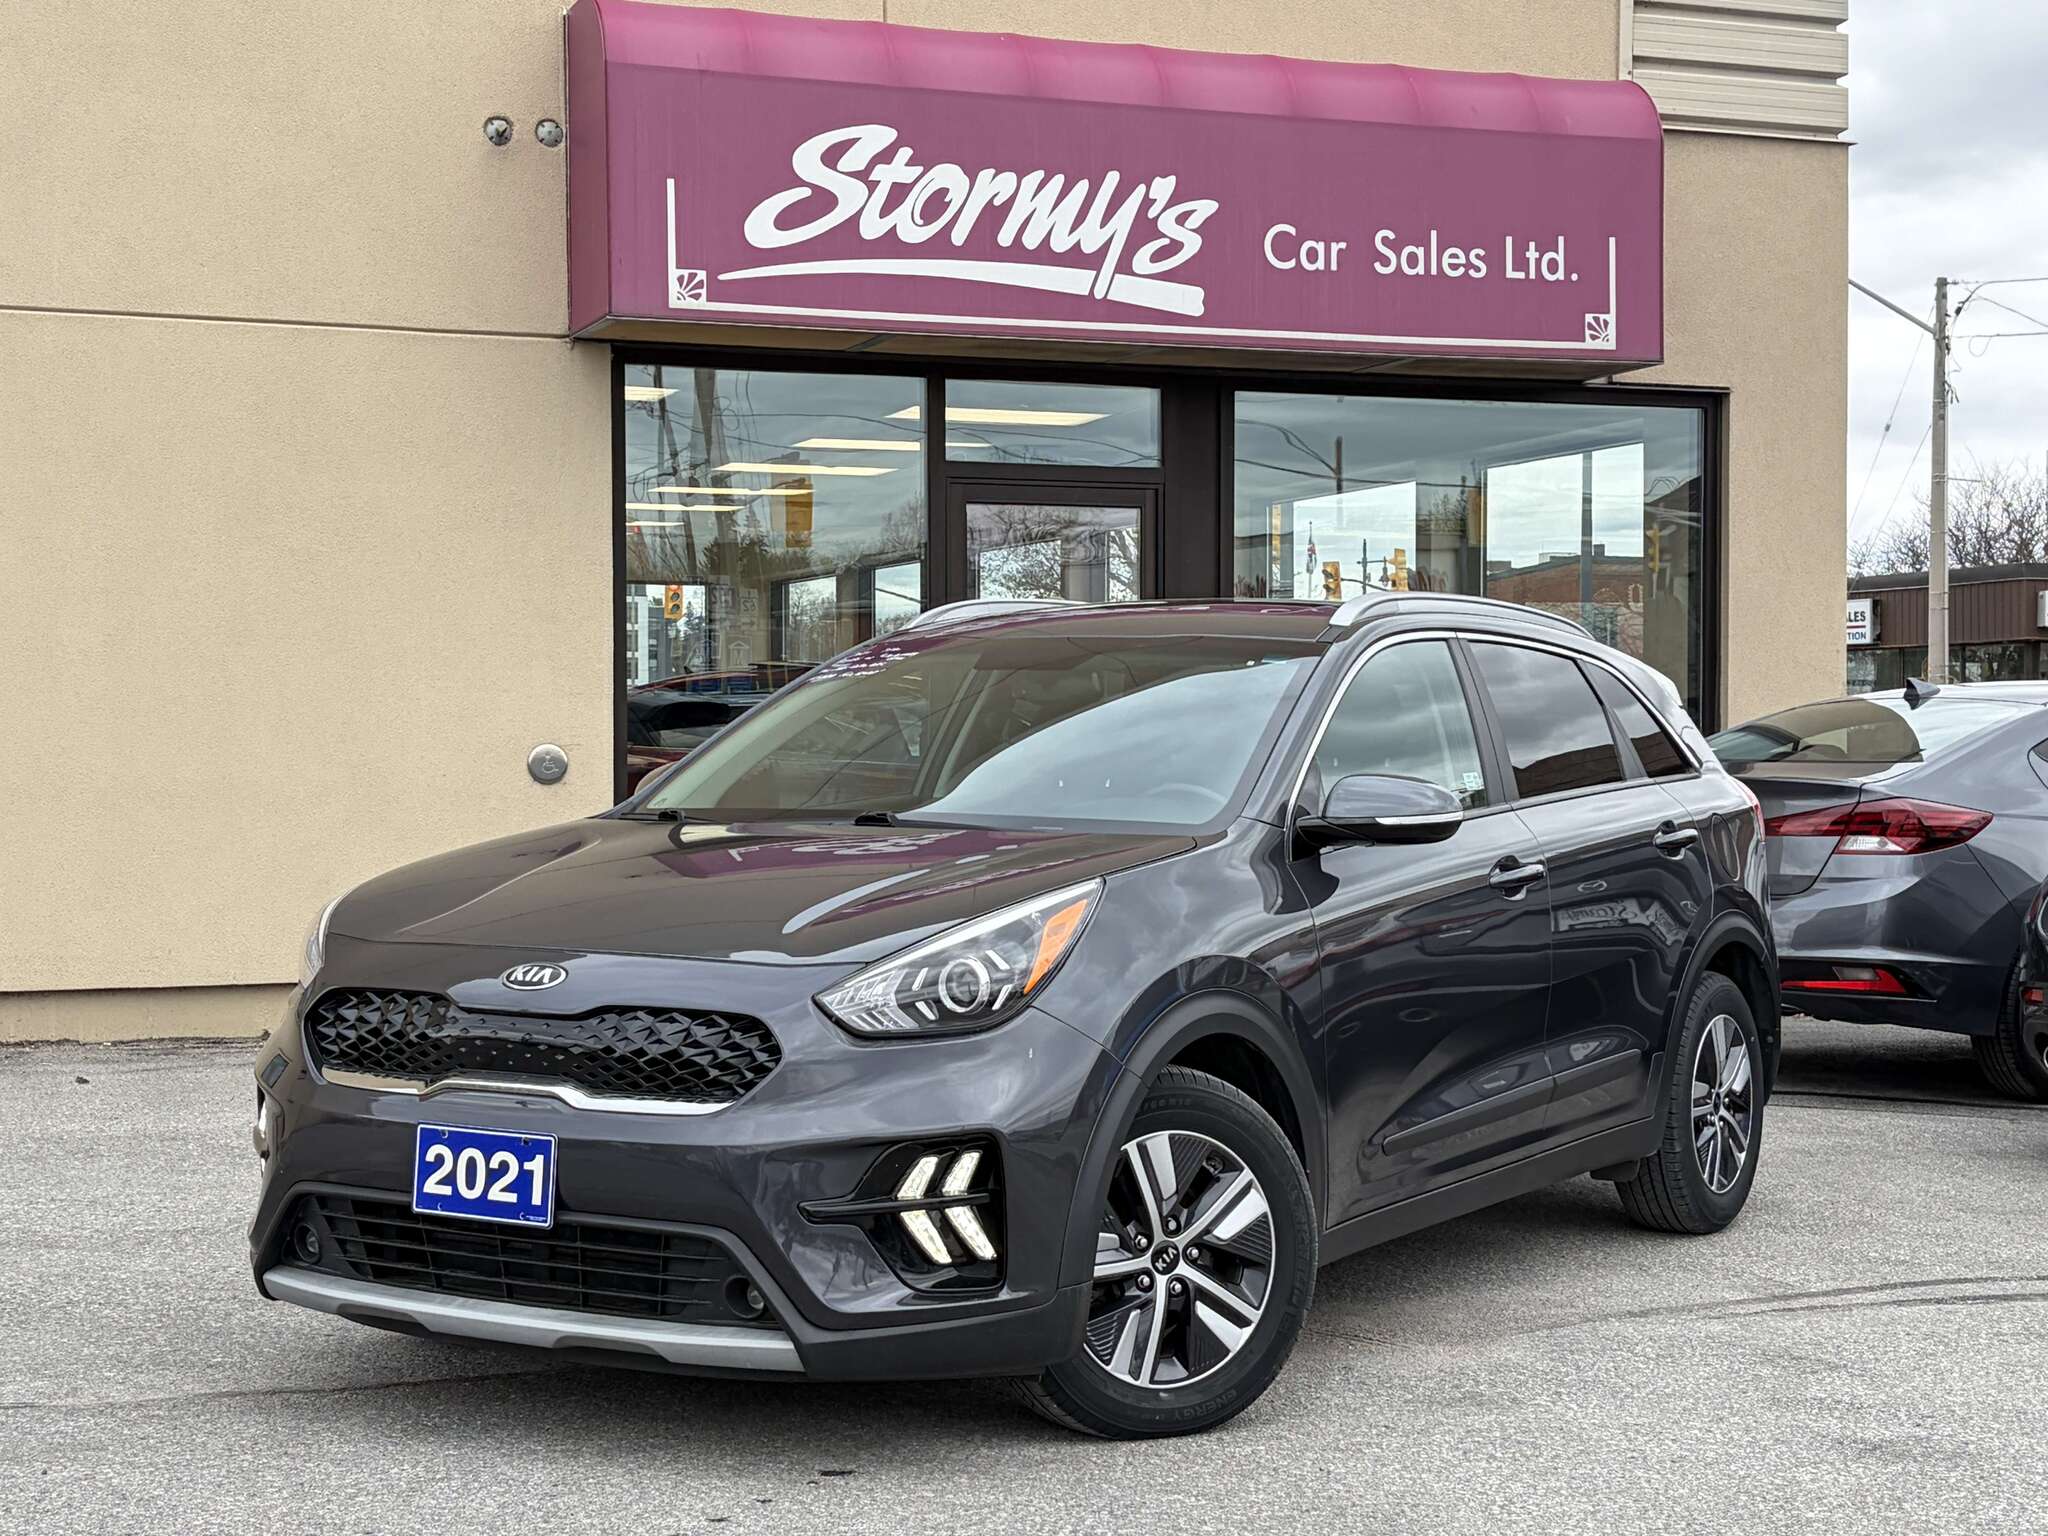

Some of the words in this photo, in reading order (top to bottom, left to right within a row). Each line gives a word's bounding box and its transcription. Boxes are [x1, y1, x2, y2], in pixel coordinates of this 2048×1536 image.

[743, 123, 1219, 300] Stormy's
[1263, 223, 1347, 272] Car
[1374, 229, 1487, 279] Sales
[1505, 235, 1579, 282] Ltd.
[1847, 611, 1866, 622] LES
[509, 966, 553, 984] KIA
[423, 1144, 544, 1206] 2021
[1155, 1247, 1177, 1270] KIA
